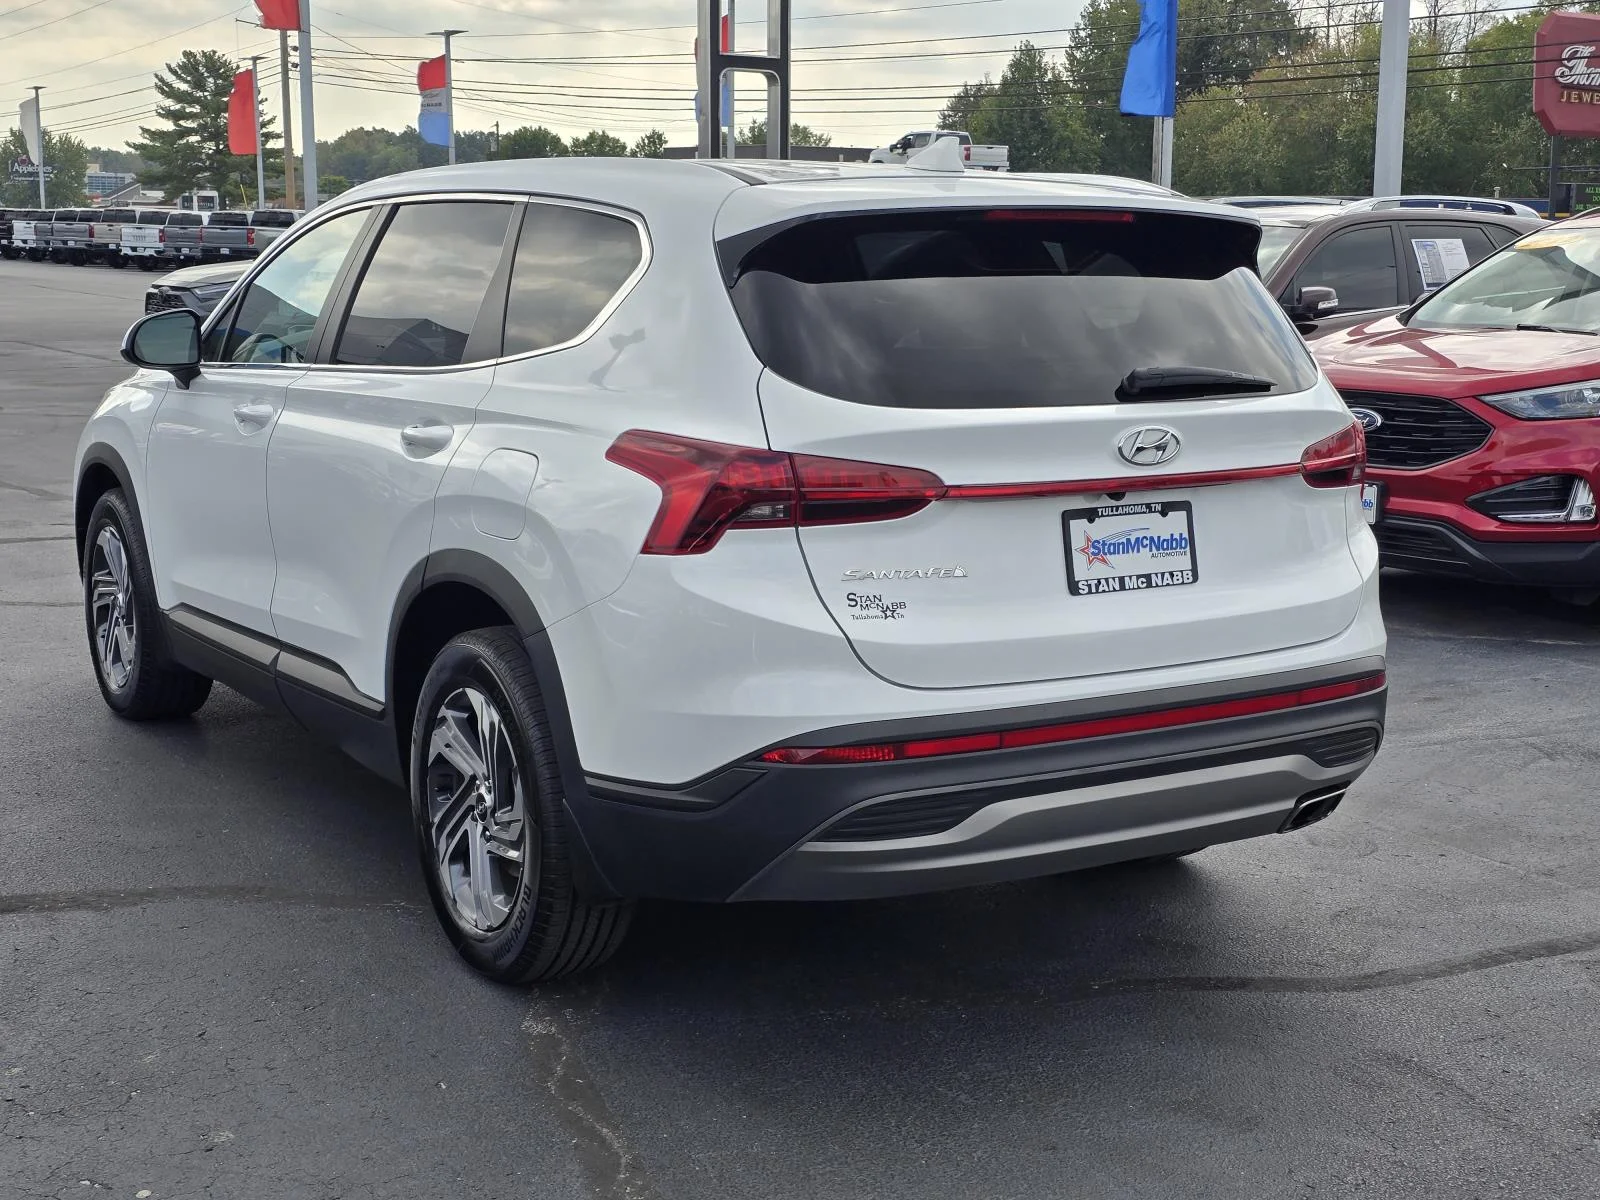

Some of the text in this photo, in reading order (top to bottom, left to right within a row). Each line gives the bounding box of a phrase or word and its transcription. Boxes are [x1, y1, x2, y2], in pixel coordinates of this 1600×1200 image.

[1097, 503, 1162, 516] TULLAHOMA, TN
[1150, 550, 1188, 559] AUTOMOTIVE
[1078, 570, 1193, 595] STAN Mc NABB
